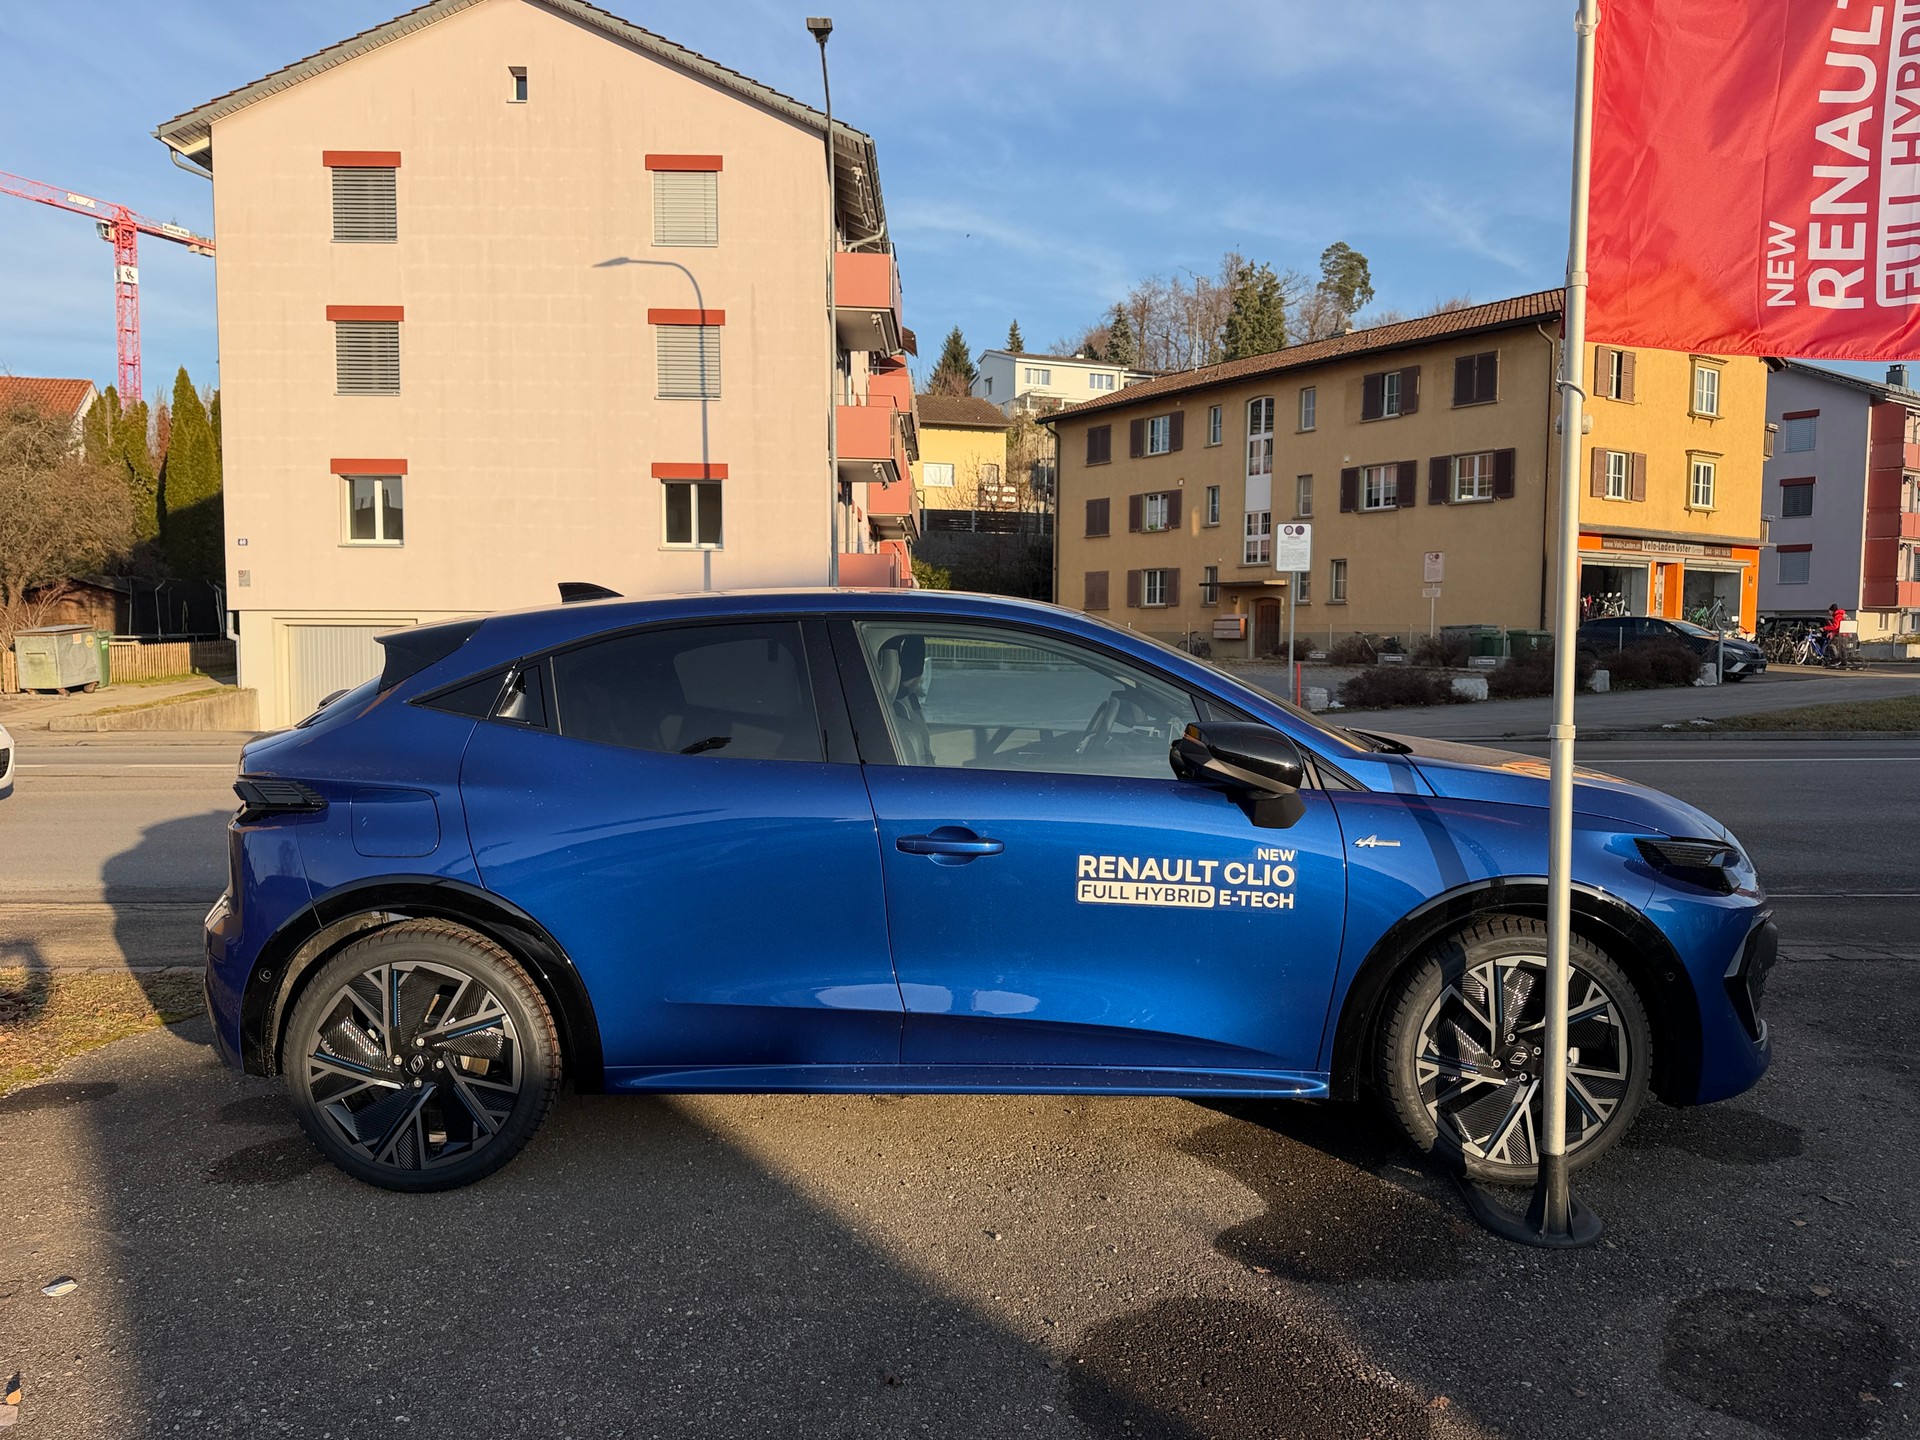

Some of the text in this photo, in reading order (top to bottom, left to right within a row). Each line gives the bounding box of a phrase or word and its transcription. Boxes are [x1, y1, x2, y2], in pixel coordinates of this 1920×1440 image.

[1807, 0, 1885, 310] RENAUL
[1766, 221, 1796, 308] NEW
[1644, 540, 1675, 552] Velo-Laden
[1676, 543, 1691, 552] Uster
[1257, 847, 1295, 862] NEW
[1077, 854, 1296, 888] RENAULT CLIO
[1081, 883, 1294, 910] FULL HYBRID E-TECH
